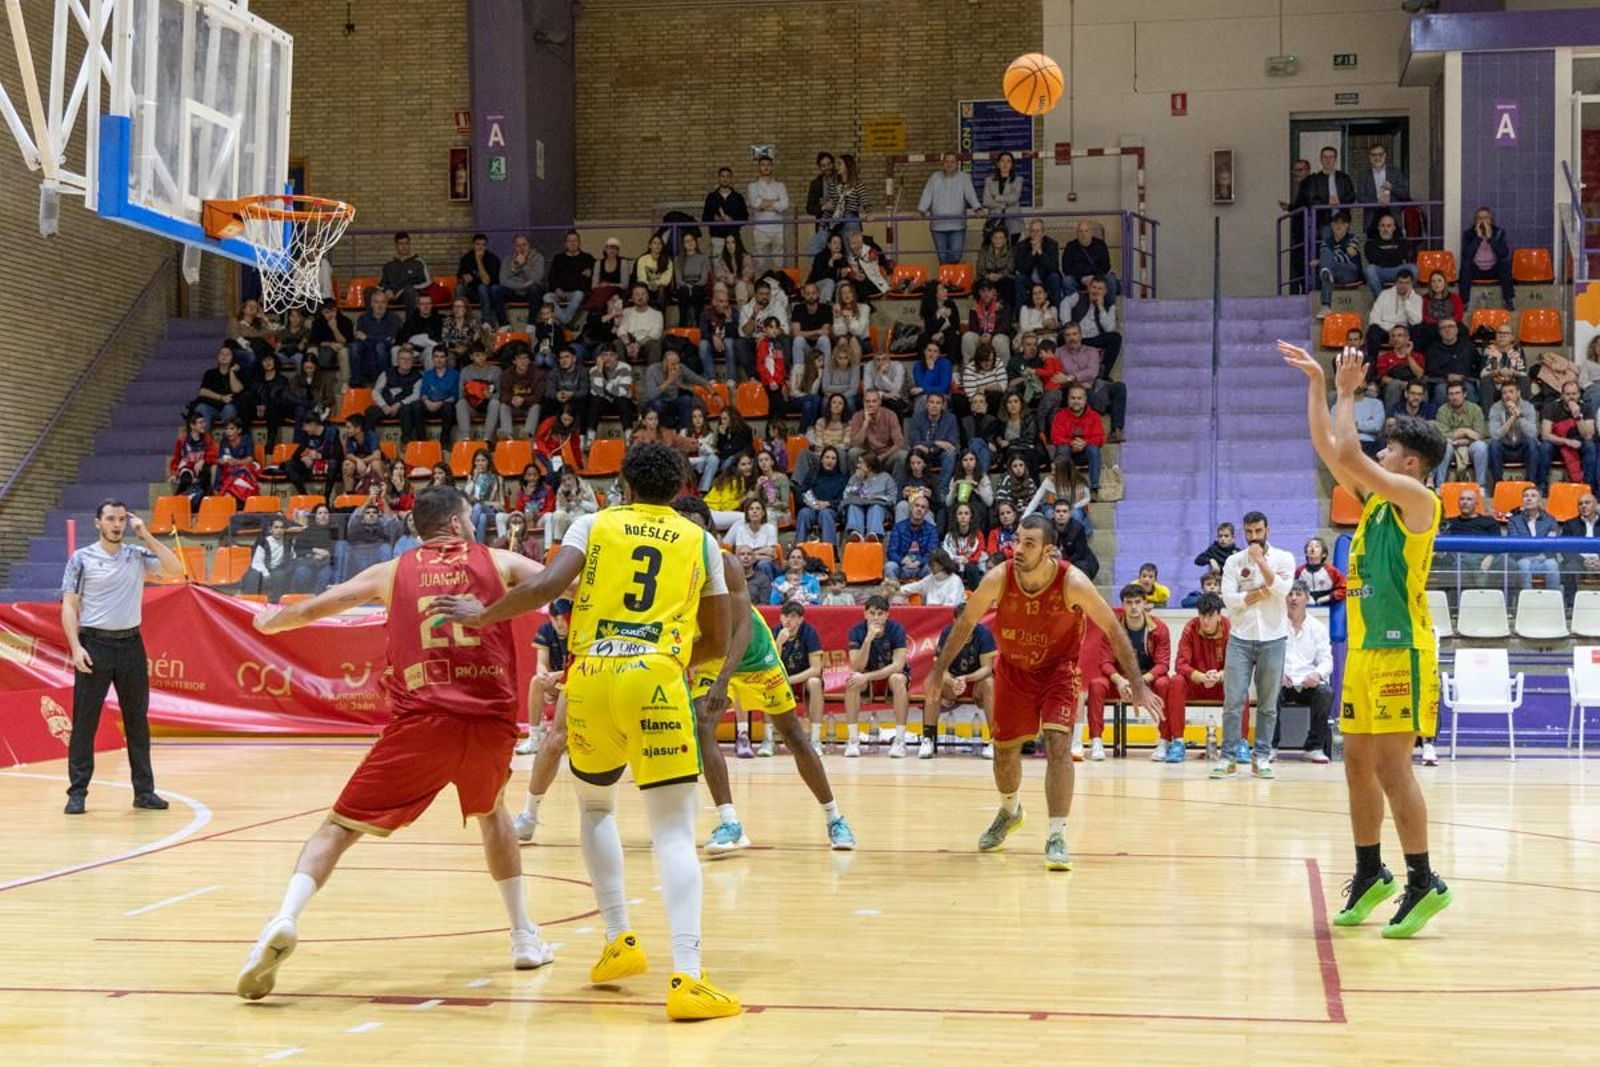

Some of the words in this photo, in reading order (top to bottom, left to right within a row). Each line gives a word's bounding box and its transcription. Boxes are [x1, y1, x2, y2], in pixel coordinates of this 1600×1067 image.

[488, 122, 505, 147] A
[1496, 113, 1515, 139] A
[624, 523, 680, 543] ROÉSLEY
[419, 570, 470, 588] JUANMA
[623, 545, 662, 612] 3
[1025, 600, 1040, 615] 13
